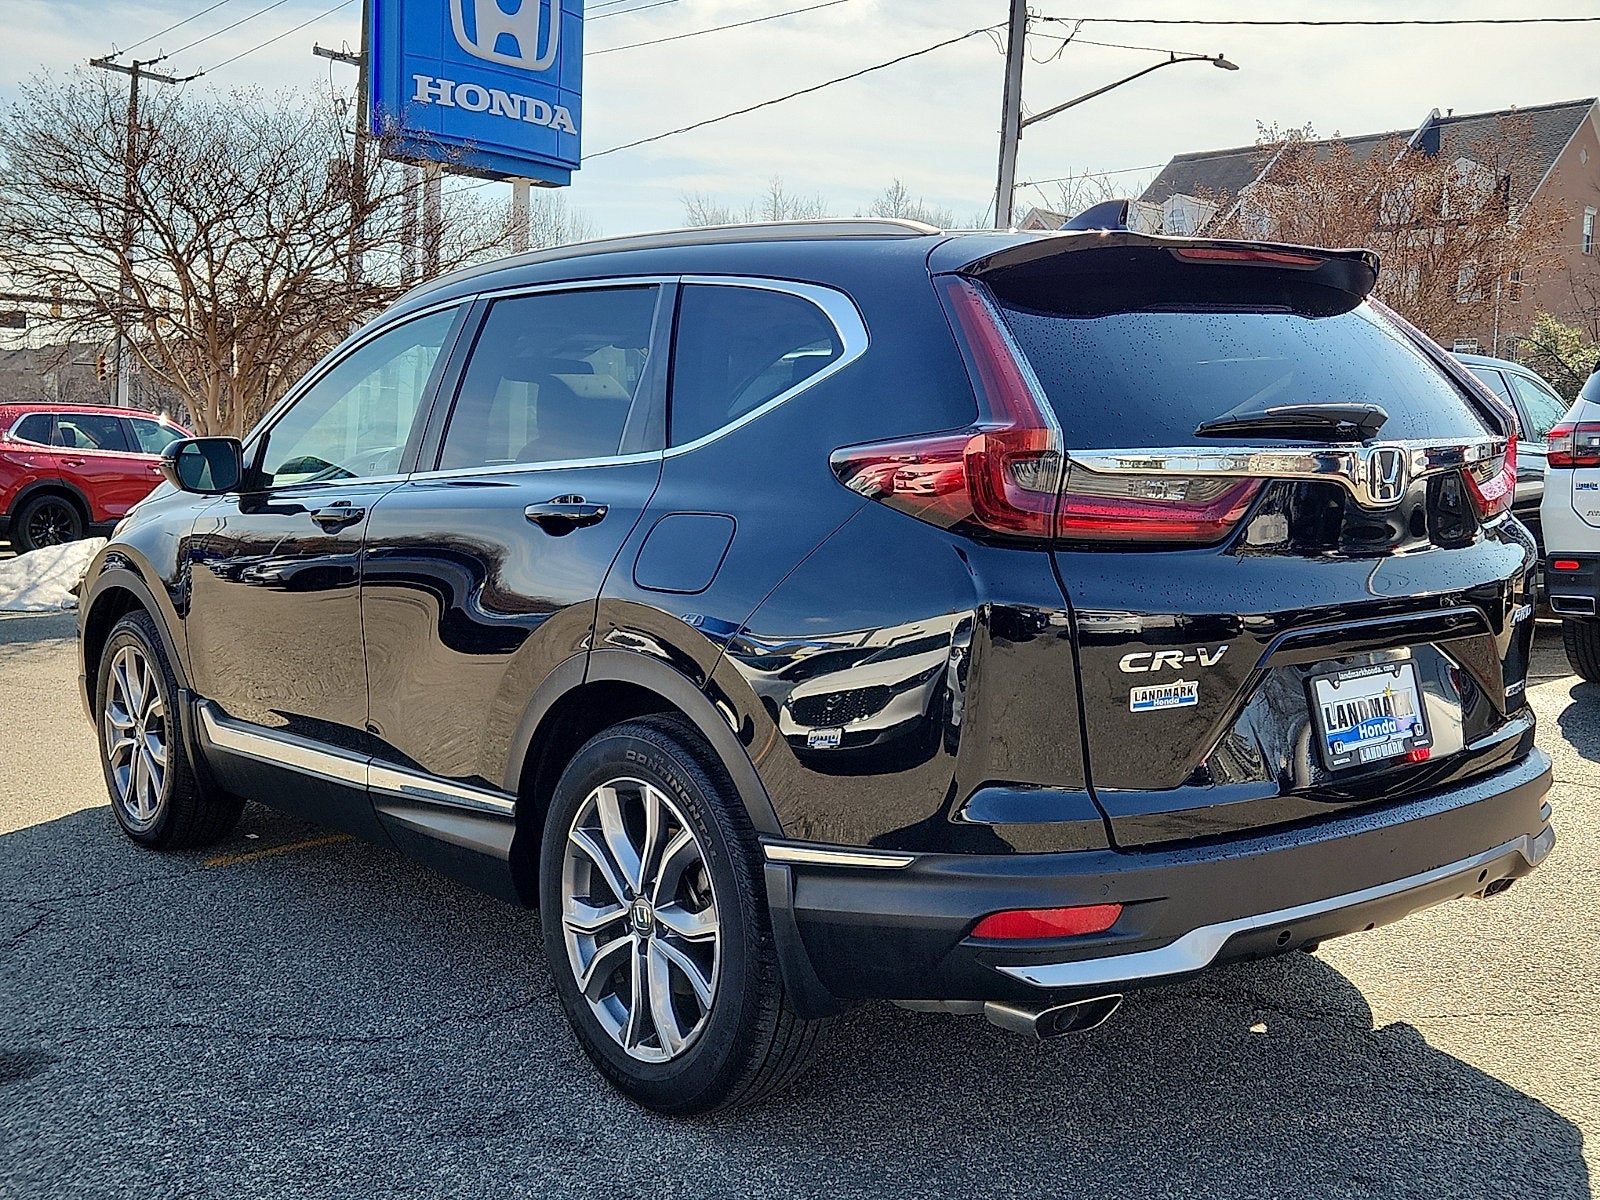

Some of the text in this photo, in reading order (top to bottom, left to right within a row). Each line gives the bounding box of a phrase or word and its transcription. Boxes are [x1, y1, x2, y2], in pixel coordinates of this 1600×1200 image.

[411, 74, 577, 135] HONDA
[1119, 645, 1229, 672] CR-V
[1134, 685, 1194, 702] LANDMARK
[1153, 697, 1180, 707] Honda
[1324, 691, 1415, 732] LANDMAK
[1359, 719, 1397, 740] Honda
[1360, 740, 1406, 763] LANDMARK
[626, 750, 717, 866] CONTINENTAL
